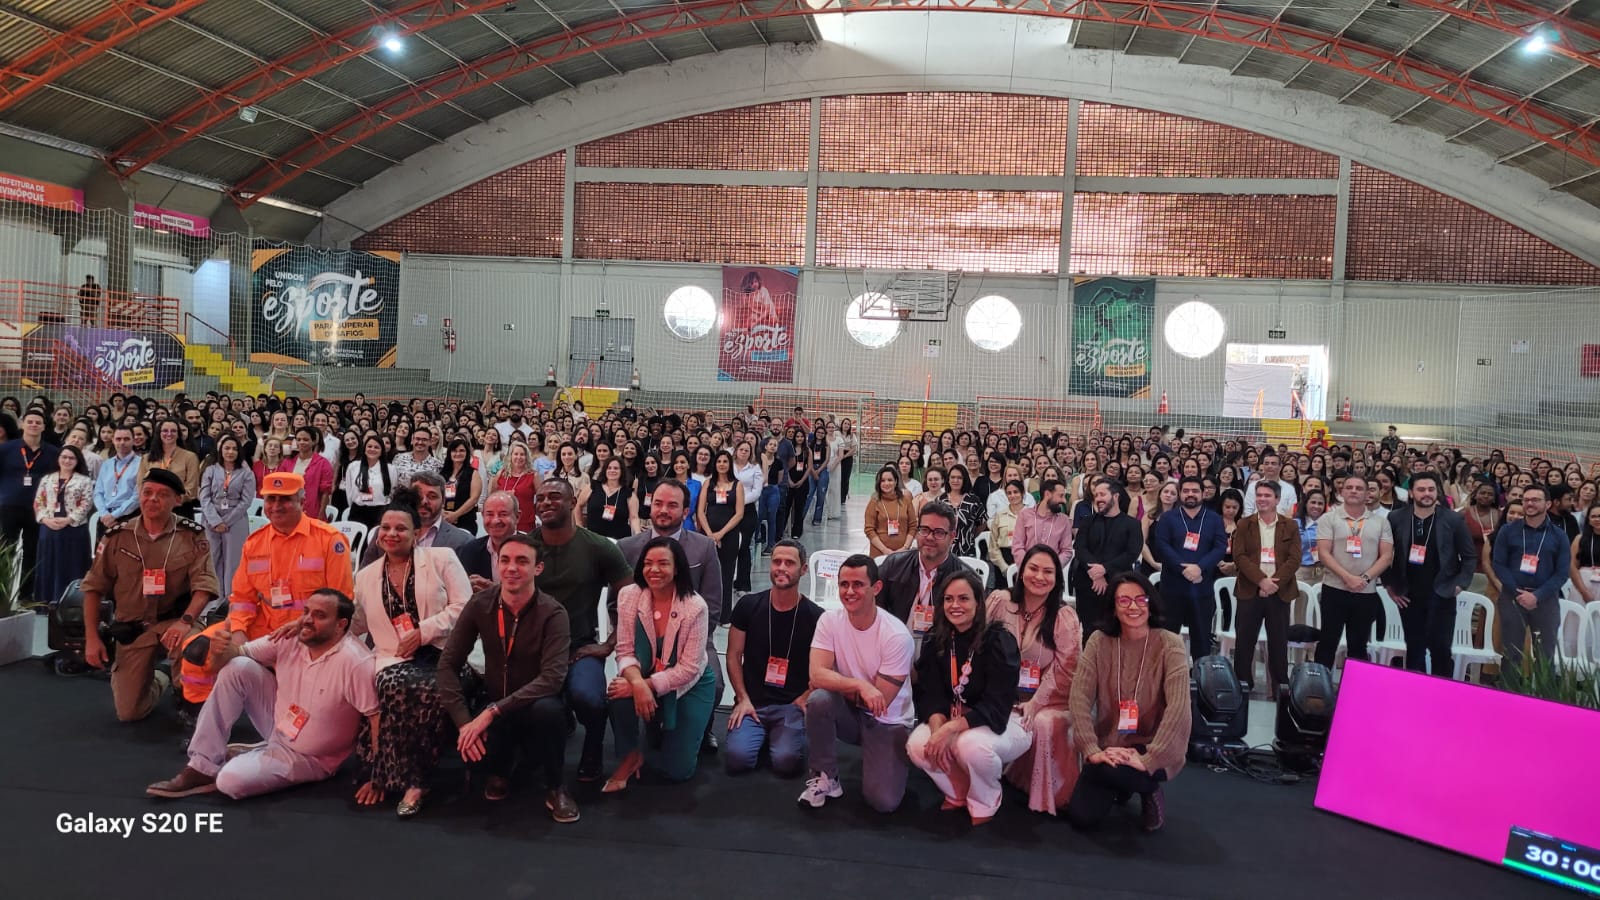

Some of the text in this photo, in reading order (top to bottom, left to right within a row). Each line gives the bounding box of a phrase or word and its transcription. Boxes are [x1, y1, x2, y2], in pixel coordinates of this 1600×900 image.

[35, 185, 45, 193] DE
[265, 279, 283, 288] PELO
[275, 271, 305, 282] UNIDOS
[263, 269, 384, 340] esporte
[724, 323, 790, 361] esporte
[1076, 337, 1148, 376] esporte
